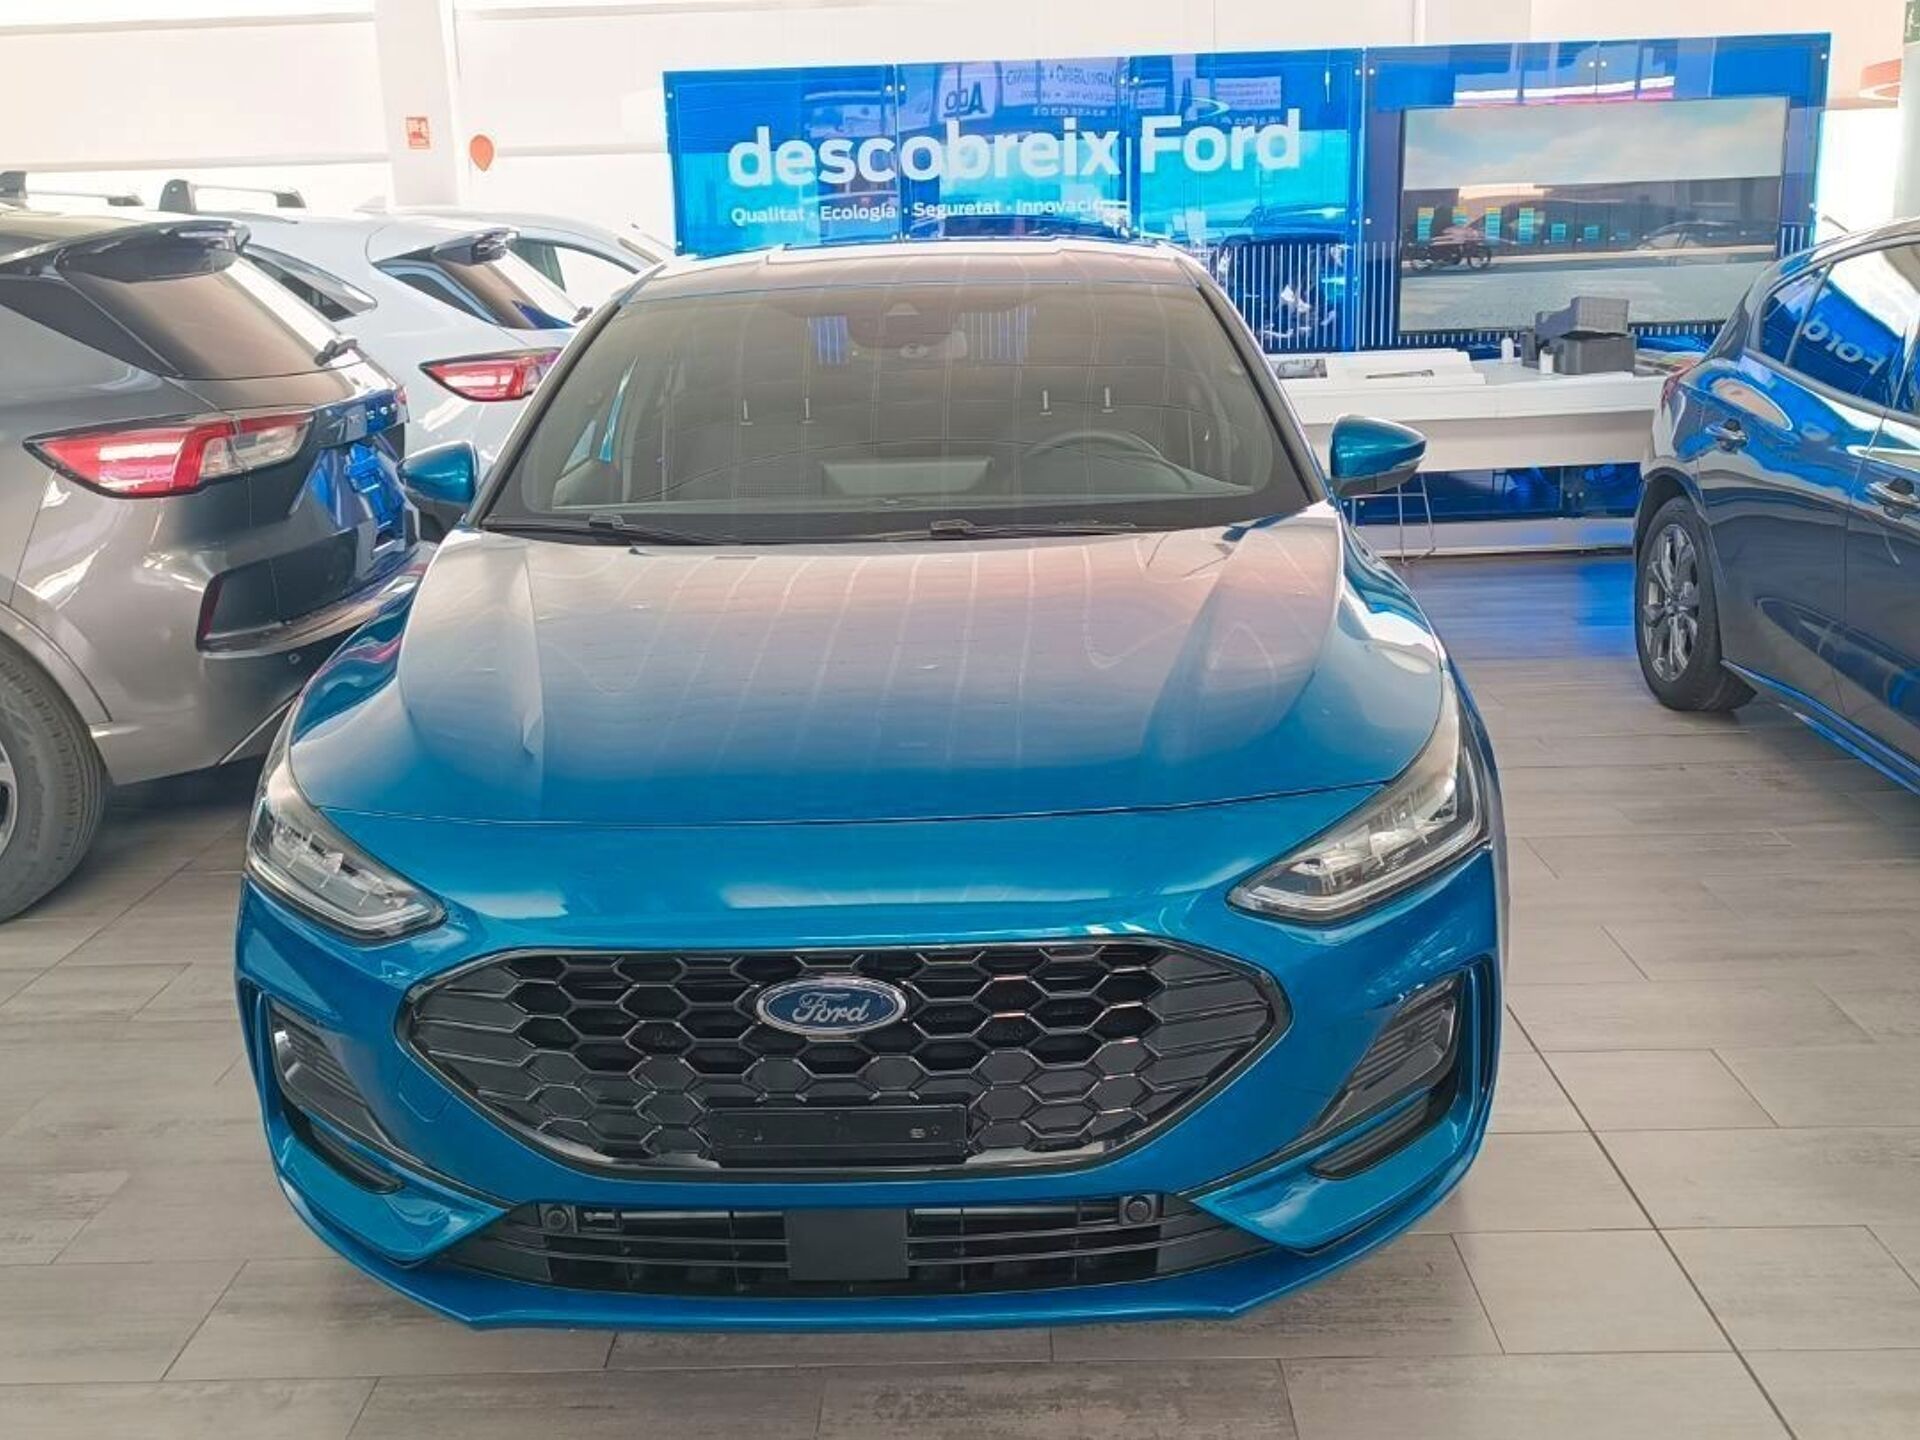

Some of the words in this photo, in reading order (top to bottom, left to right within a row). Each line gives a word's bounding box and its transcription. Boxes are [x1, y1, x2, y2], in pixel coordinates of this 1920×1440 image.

[730, 119, 1120, 187] descobreix
[1141, 108, 1299, 173] Ford
[731, 206, 804, 226] Qualitat
[820, 203, 897, 222] Ecología
[911, 200, 1001, 219] Seguretat
[792, 991, 871, 1023] Ford
